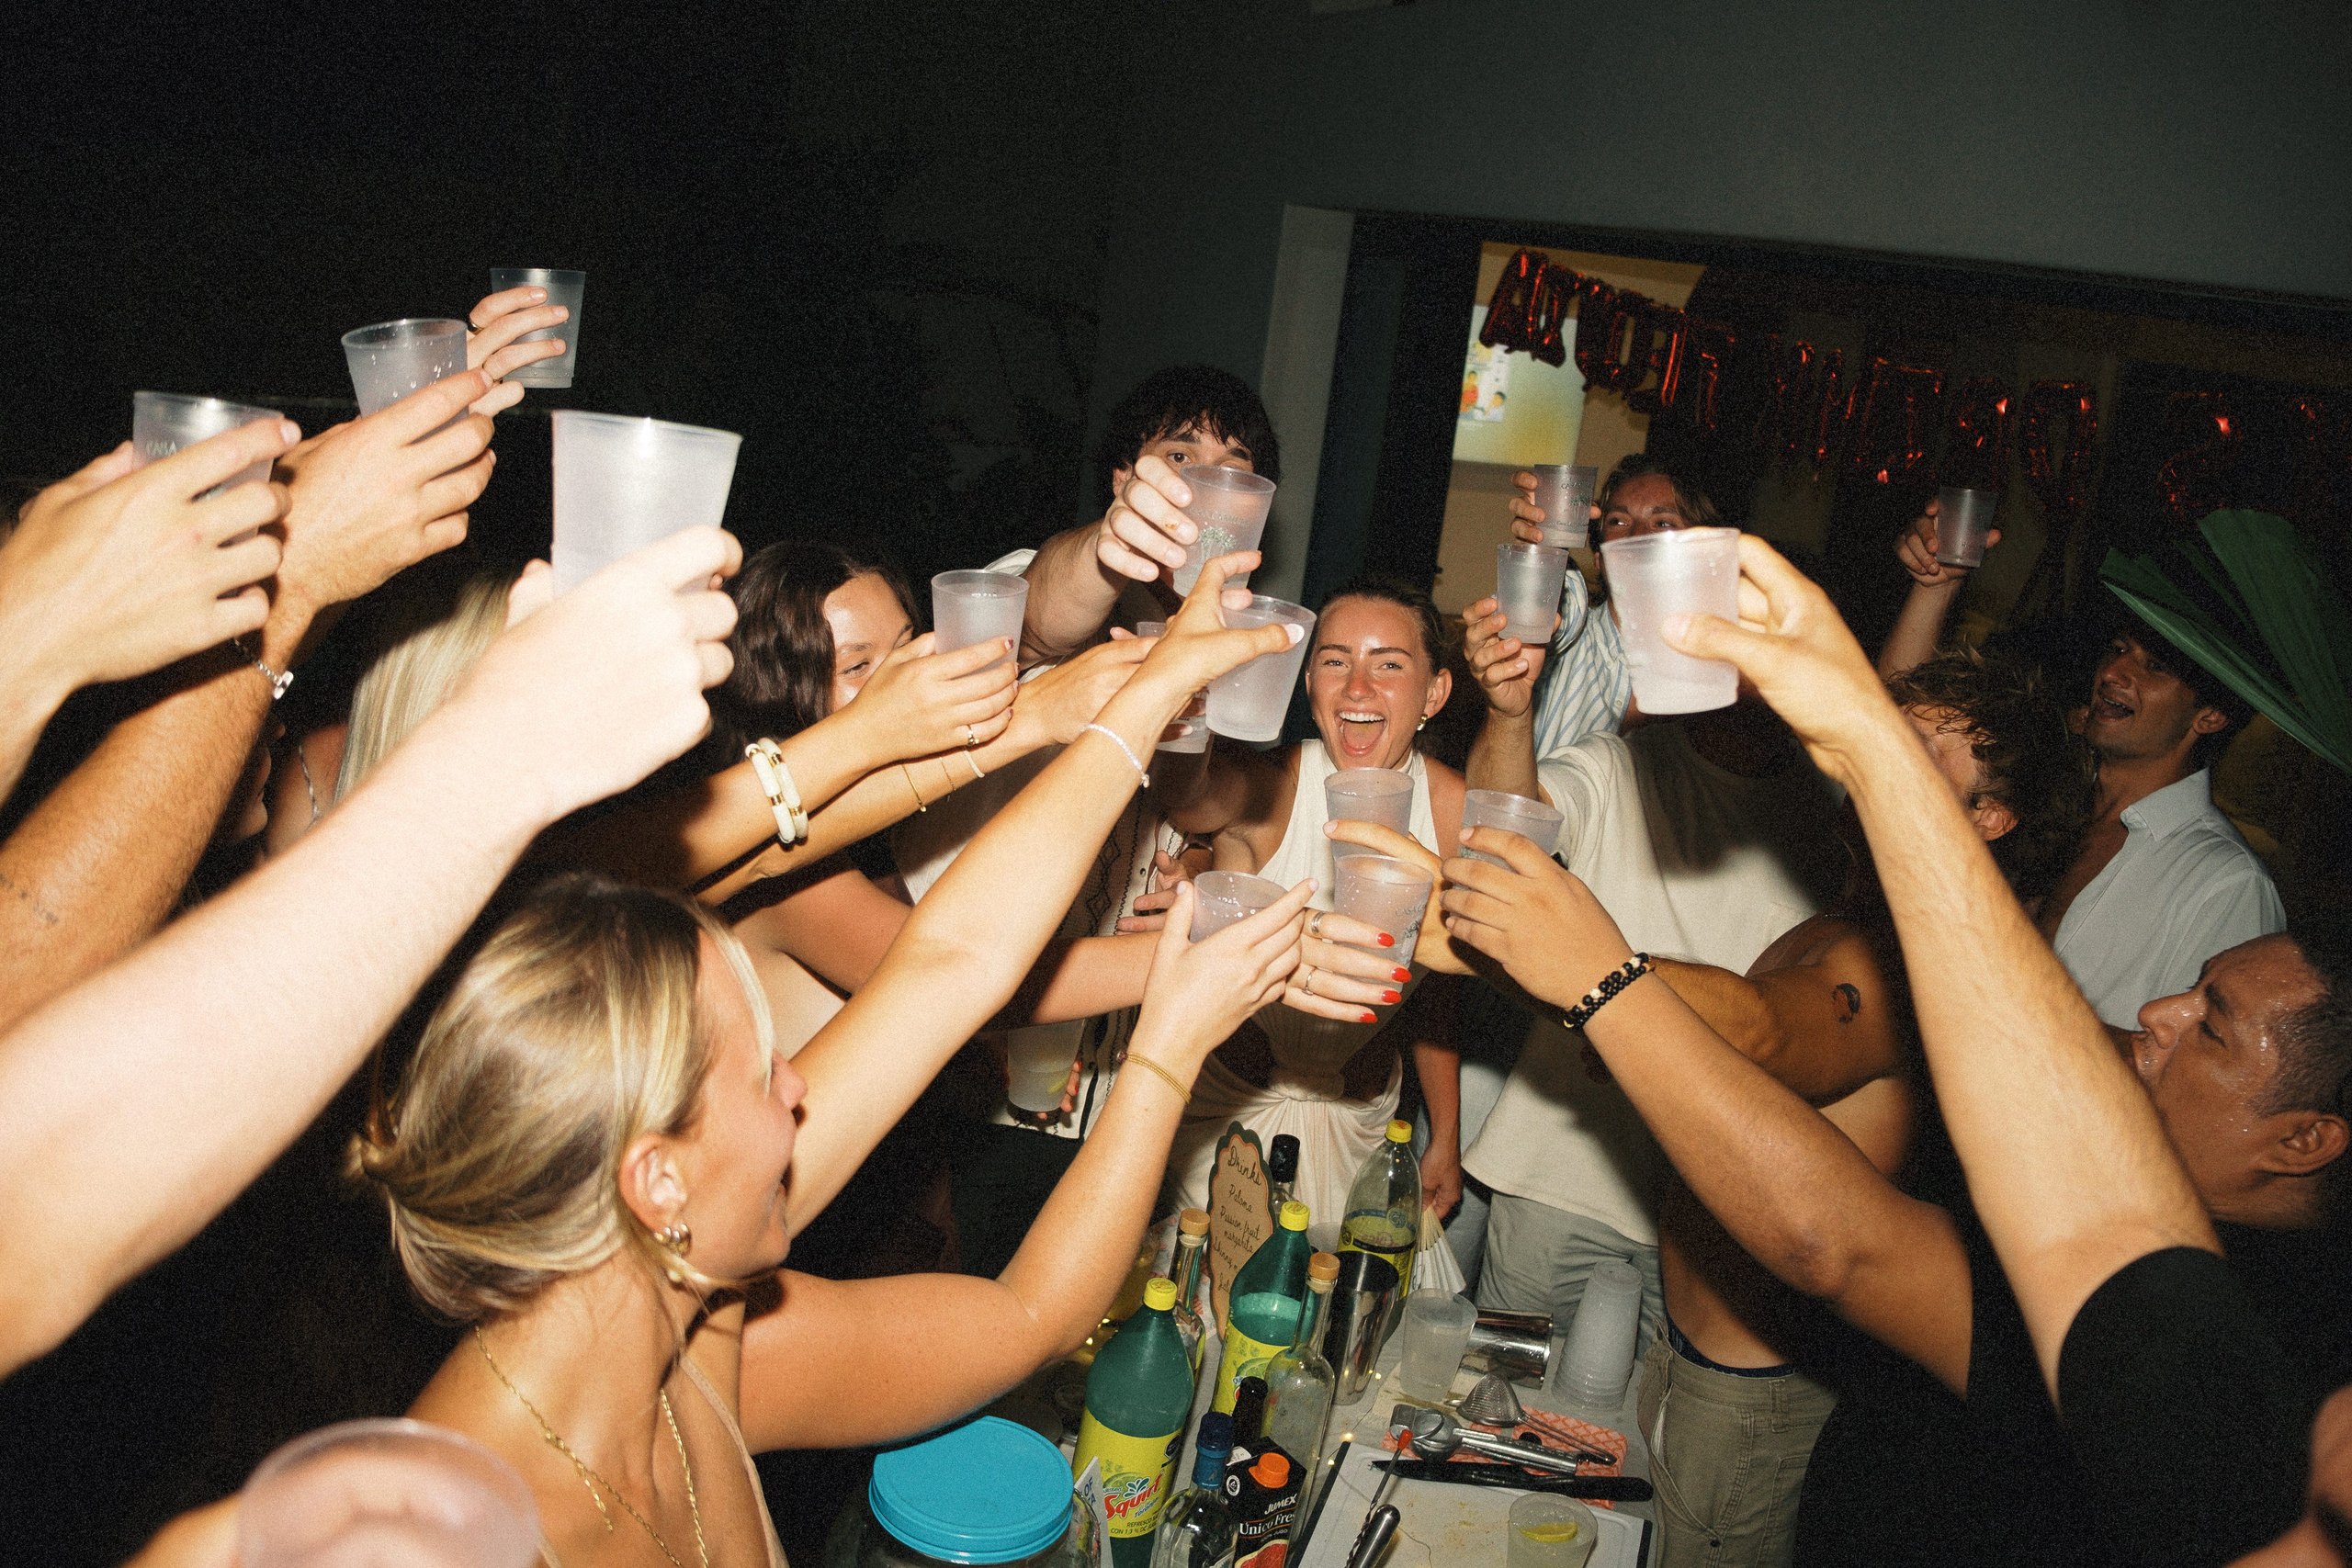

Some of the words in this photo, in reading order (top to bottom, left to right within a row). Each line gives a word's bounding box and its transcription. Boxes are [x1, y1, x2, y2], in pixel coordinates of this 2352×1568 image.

[1227, 1145, 1261, 1186] Drinks
[1228, 1183, 1252, 1213] Paloma
[1220, 1205, 1242, 1231] Passion
[1241, 1220, 1260, 1247] fruit
[1083, 1476, 1093, 1497] OF
[1103, 1470, 1164, 1519] Squirt
[1264, 1494, 1297, 1515] JUMEX
[1239, 1521, 1272, 1535] Único
[1272, 1513, 1295, 1526] Fre
